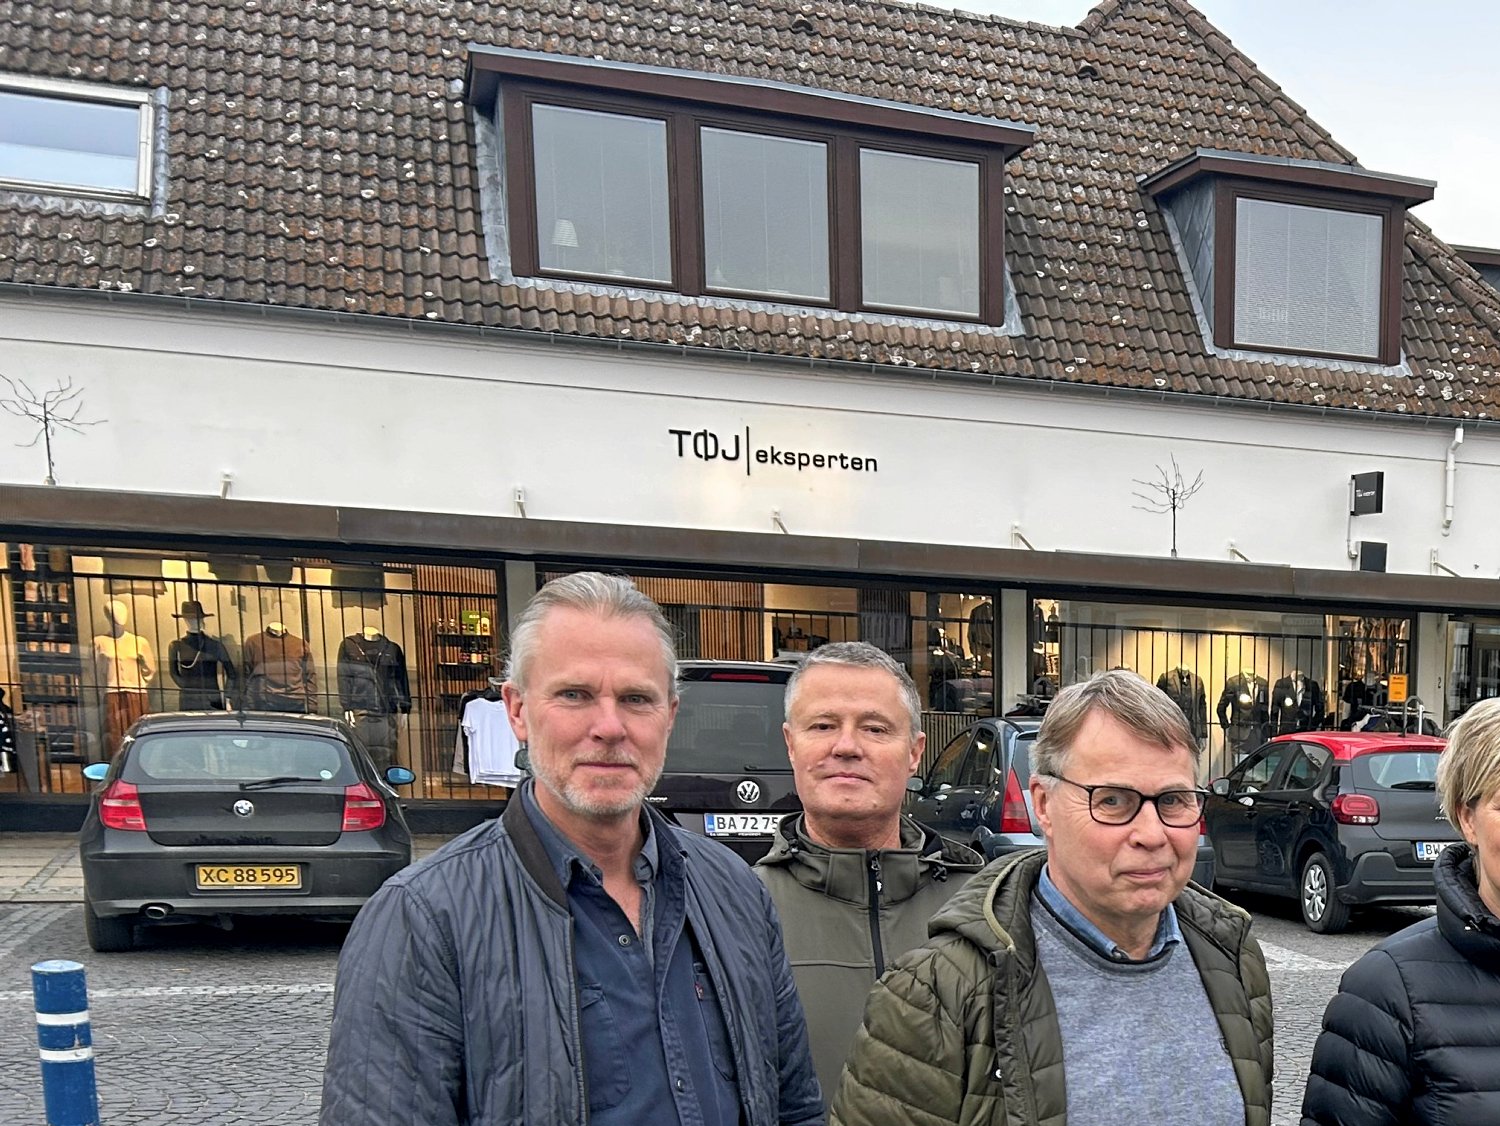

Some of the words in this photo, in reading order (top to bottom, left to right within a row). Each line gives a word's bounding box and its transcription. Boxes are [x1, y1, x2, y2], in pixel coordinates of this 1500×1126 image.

[755, 446, 878, 472] eksperten
[716, 817, 737, 830] BA
[202, 868, 229, 883] XC
